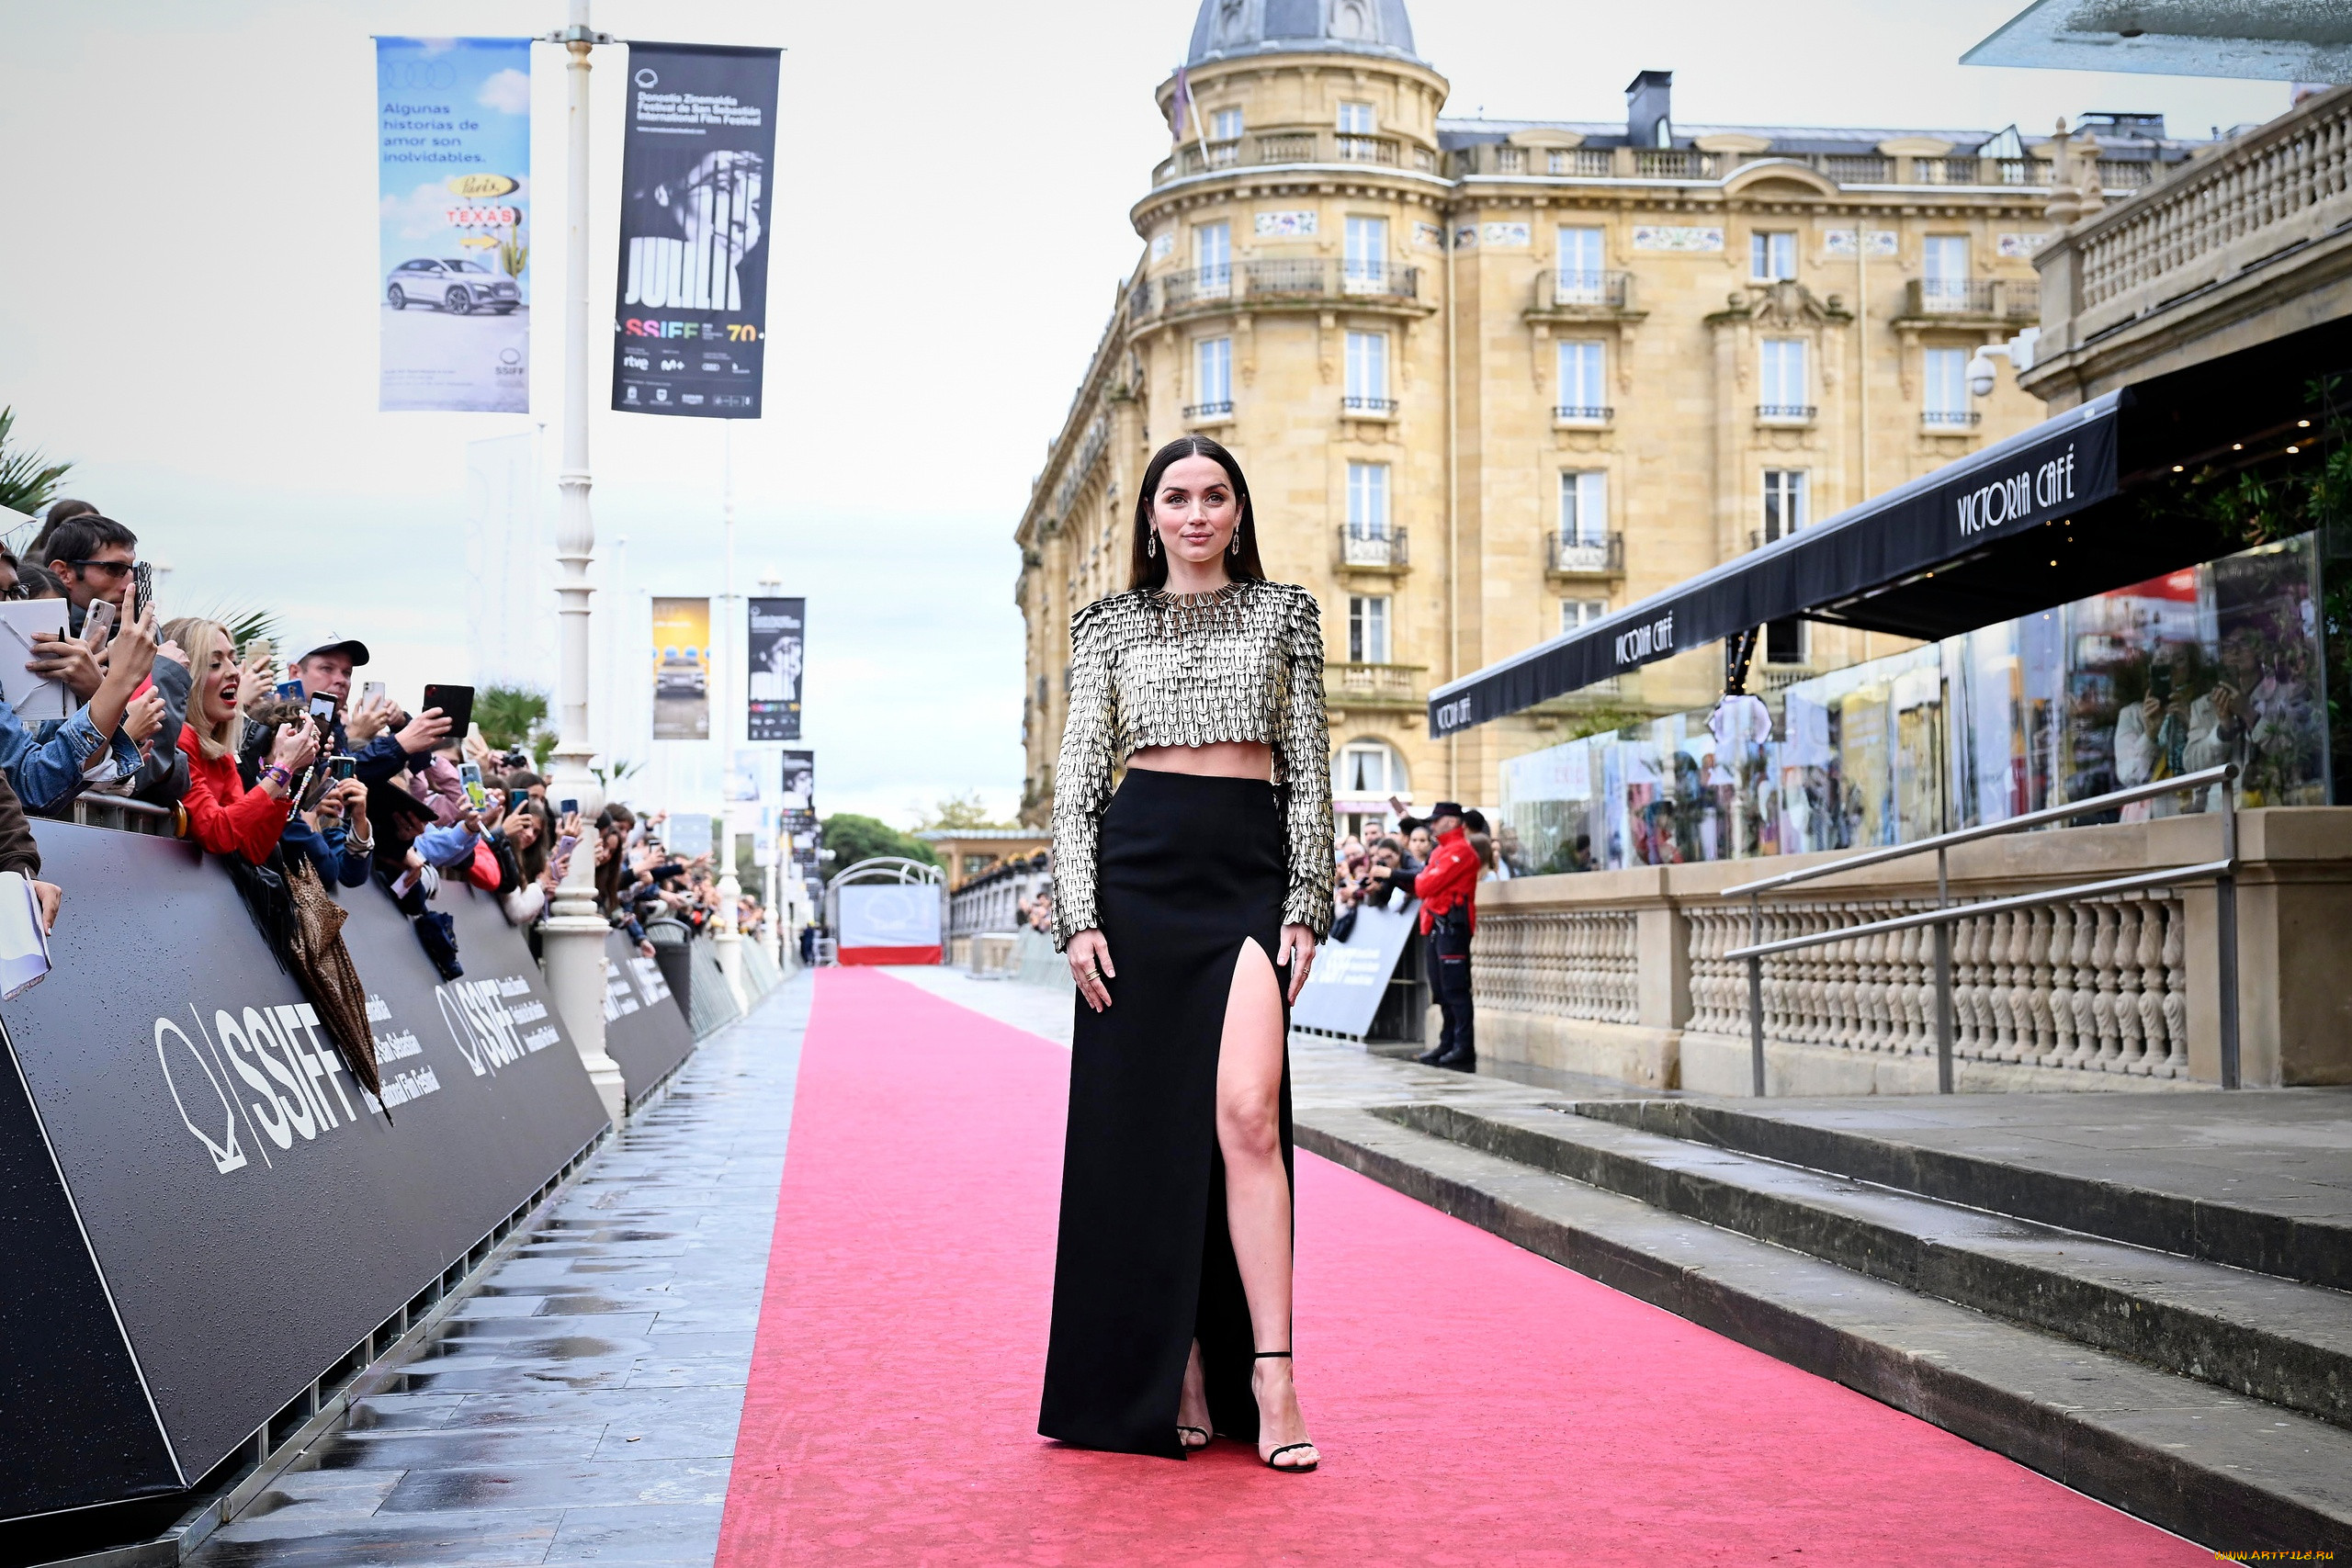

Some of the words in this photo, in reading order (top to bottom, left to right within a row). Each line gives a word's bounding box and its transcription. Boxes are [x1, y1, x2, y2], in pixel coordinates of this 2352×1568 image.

[383, 103, 450, 117] Algunas
[383, 119, 454, 130] historias
[459, 118, 480, 130] de
[383, 137, 425, 146] amor
[433, 137, 461, 146] son
[383, 152, 486, 164] inolvidables.
[447, 209, 512, 223] TEXAS
[626, 319, 699, 339] SSIFF
[727, 324, 756, 343] 70
[624, 355, 649, 371] rtve
[1957, 471, 2030, 537] VICTORIA
[2036, 443, 2075, 507] CAFÉ
[456, 979, 526, 1068] SSIFF
[374, 1035, 396, 1063] San
[215, 1002, 357, 1149] SSIFF
[397, 1072, 422, 1100] Film
[411, 1065, 441, 1096] Festival
